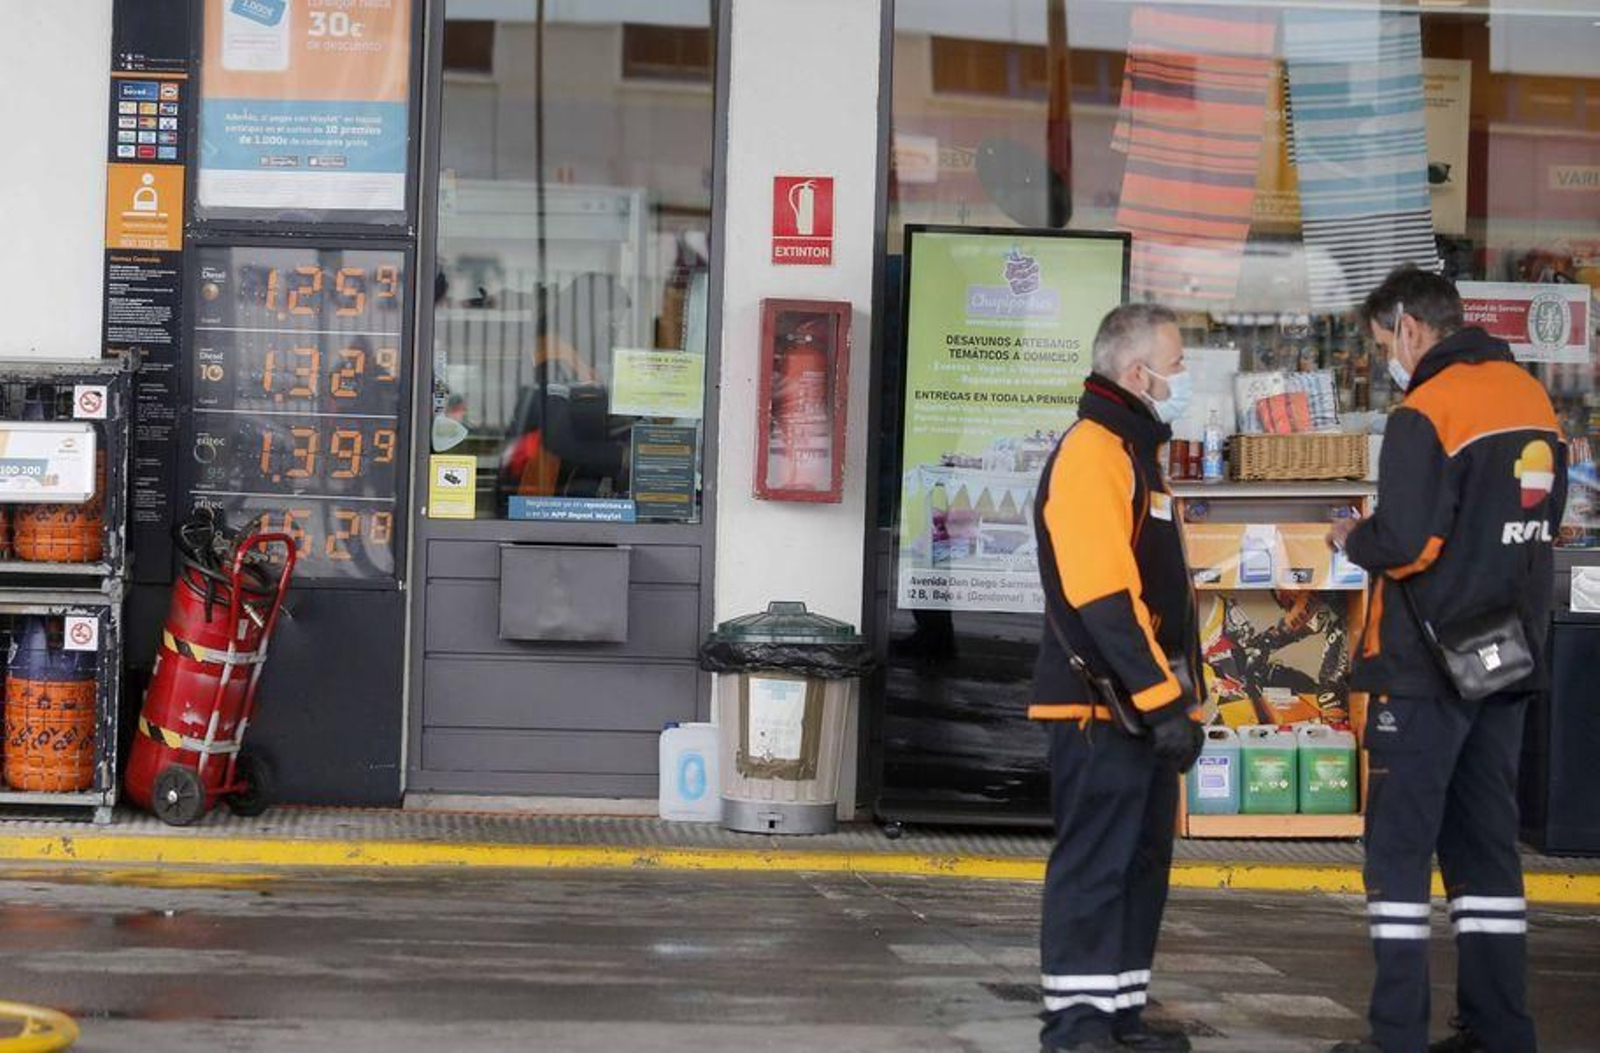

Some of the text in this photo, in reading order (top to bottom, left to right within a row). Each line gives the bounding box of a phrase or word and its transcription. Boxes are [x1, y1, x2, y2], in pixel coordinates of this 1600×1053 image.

[308, 11, 365, 37] 30€
[774, 245, 830, 259] EXTINTOR
[202, 270, 226, 279] Diesel
[946, 334, 1081, 350] DESAYUNOS ARTESANOS
[199, 353, 224, 361] Diesel
[1012, 351, 1021, 361] A
[1023, 352, 1080, 364] DOMICILIO
[914, 390, 971, 402] ENTREGAS
[973, 392, 989, 402] EN
[991, 393, 1018, 403] TODA
[1020, 394, 1034, 404] LA
[909, 576, 947, 587] Avenida
[970, 578, 998, 589] Diego
[932, 588, 955, 602] Bajo
